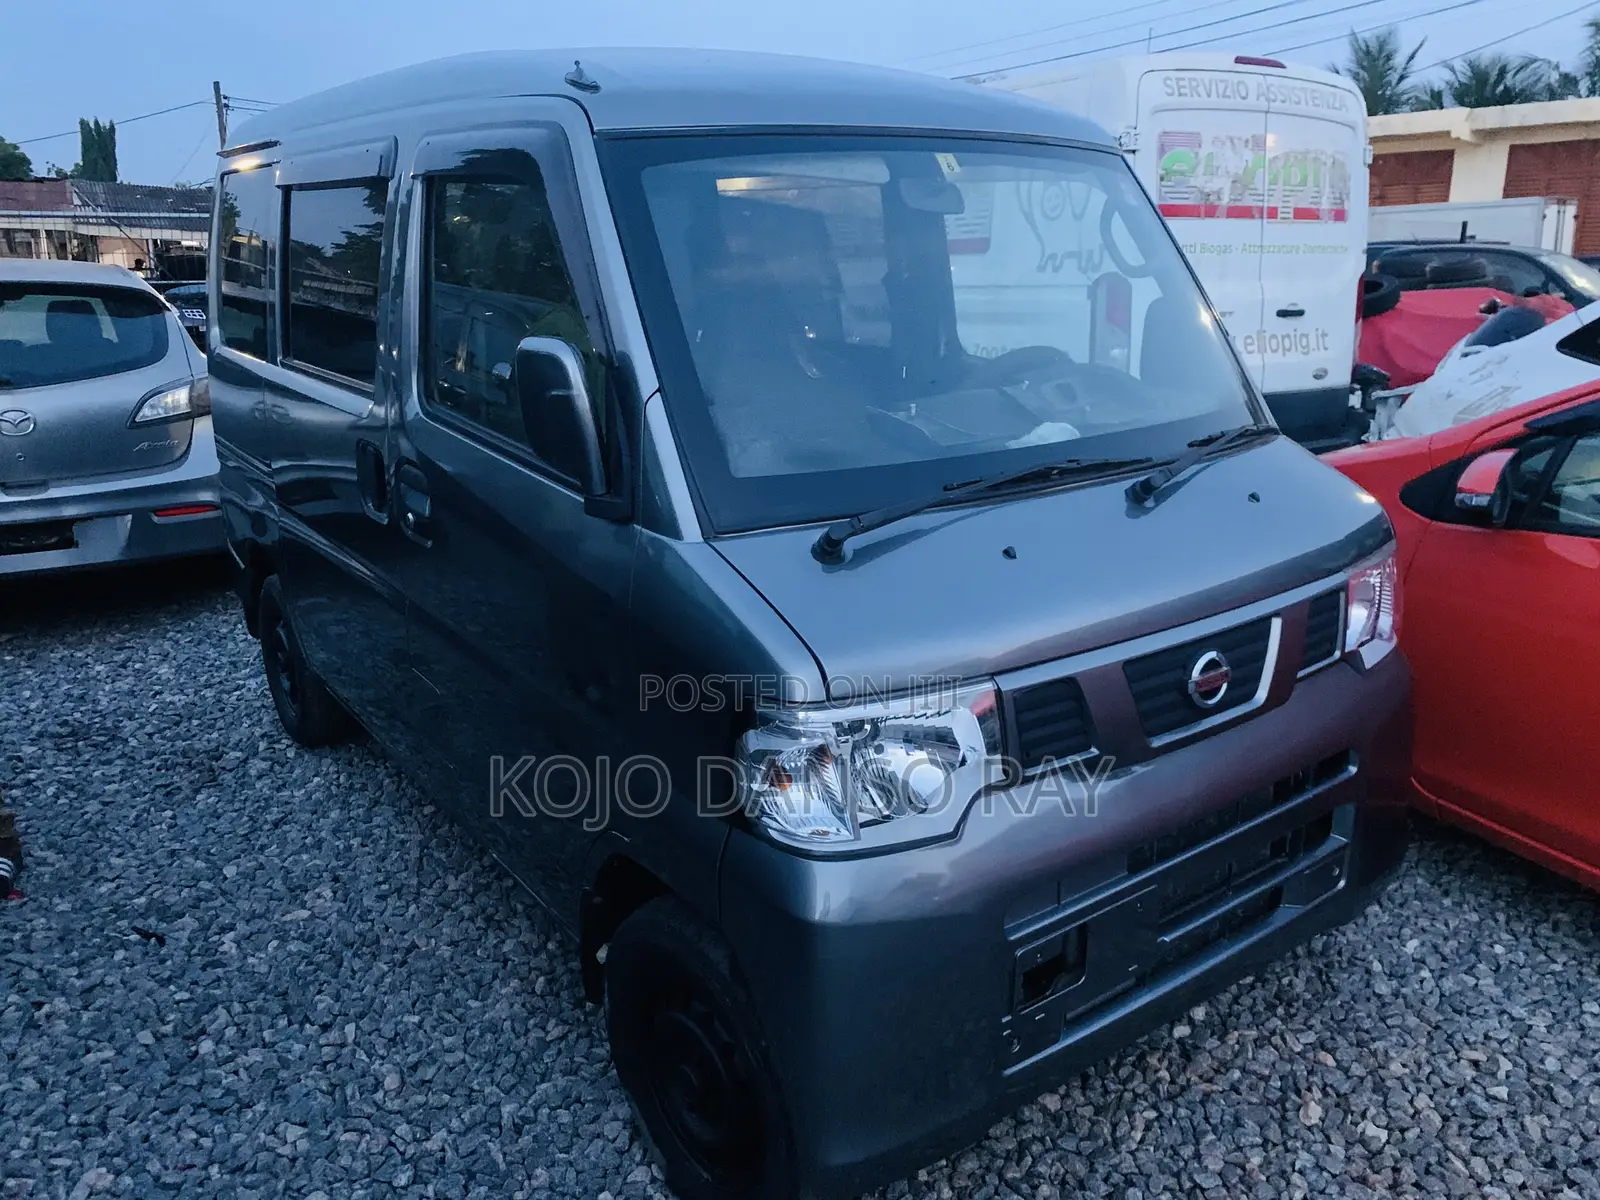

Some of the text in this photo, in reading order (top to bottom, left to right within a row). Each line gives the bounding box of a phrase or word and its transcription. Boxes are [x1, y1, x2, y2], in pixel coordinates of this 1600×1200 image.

[1162, 76, 1349, 113] SERVIZIO ASSISTENZA
[1200, 242, 1233, 256] Biogas
